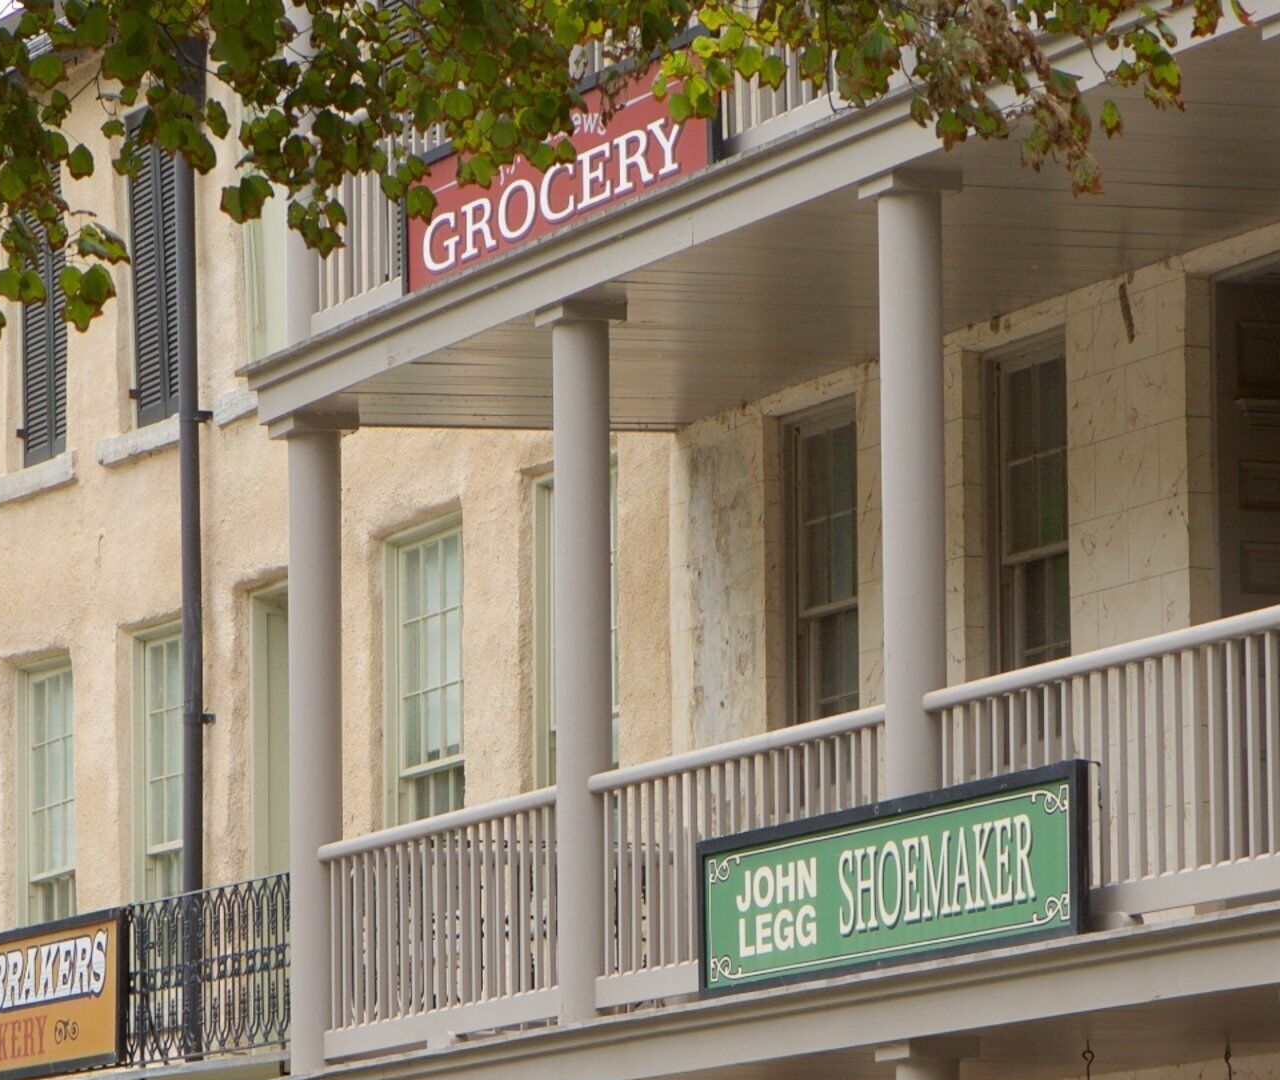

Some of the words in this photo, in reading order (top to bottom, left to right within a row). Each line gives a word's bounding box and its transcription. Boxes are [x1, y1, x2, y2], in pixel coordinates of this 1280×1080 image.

[422, 117, 682, 273] GROCERY
[735, 857, 818, 912] JOHN
[838, 813, 1037, 937] SHOEMAKER
[738, 905, 818, 958] LEGG
